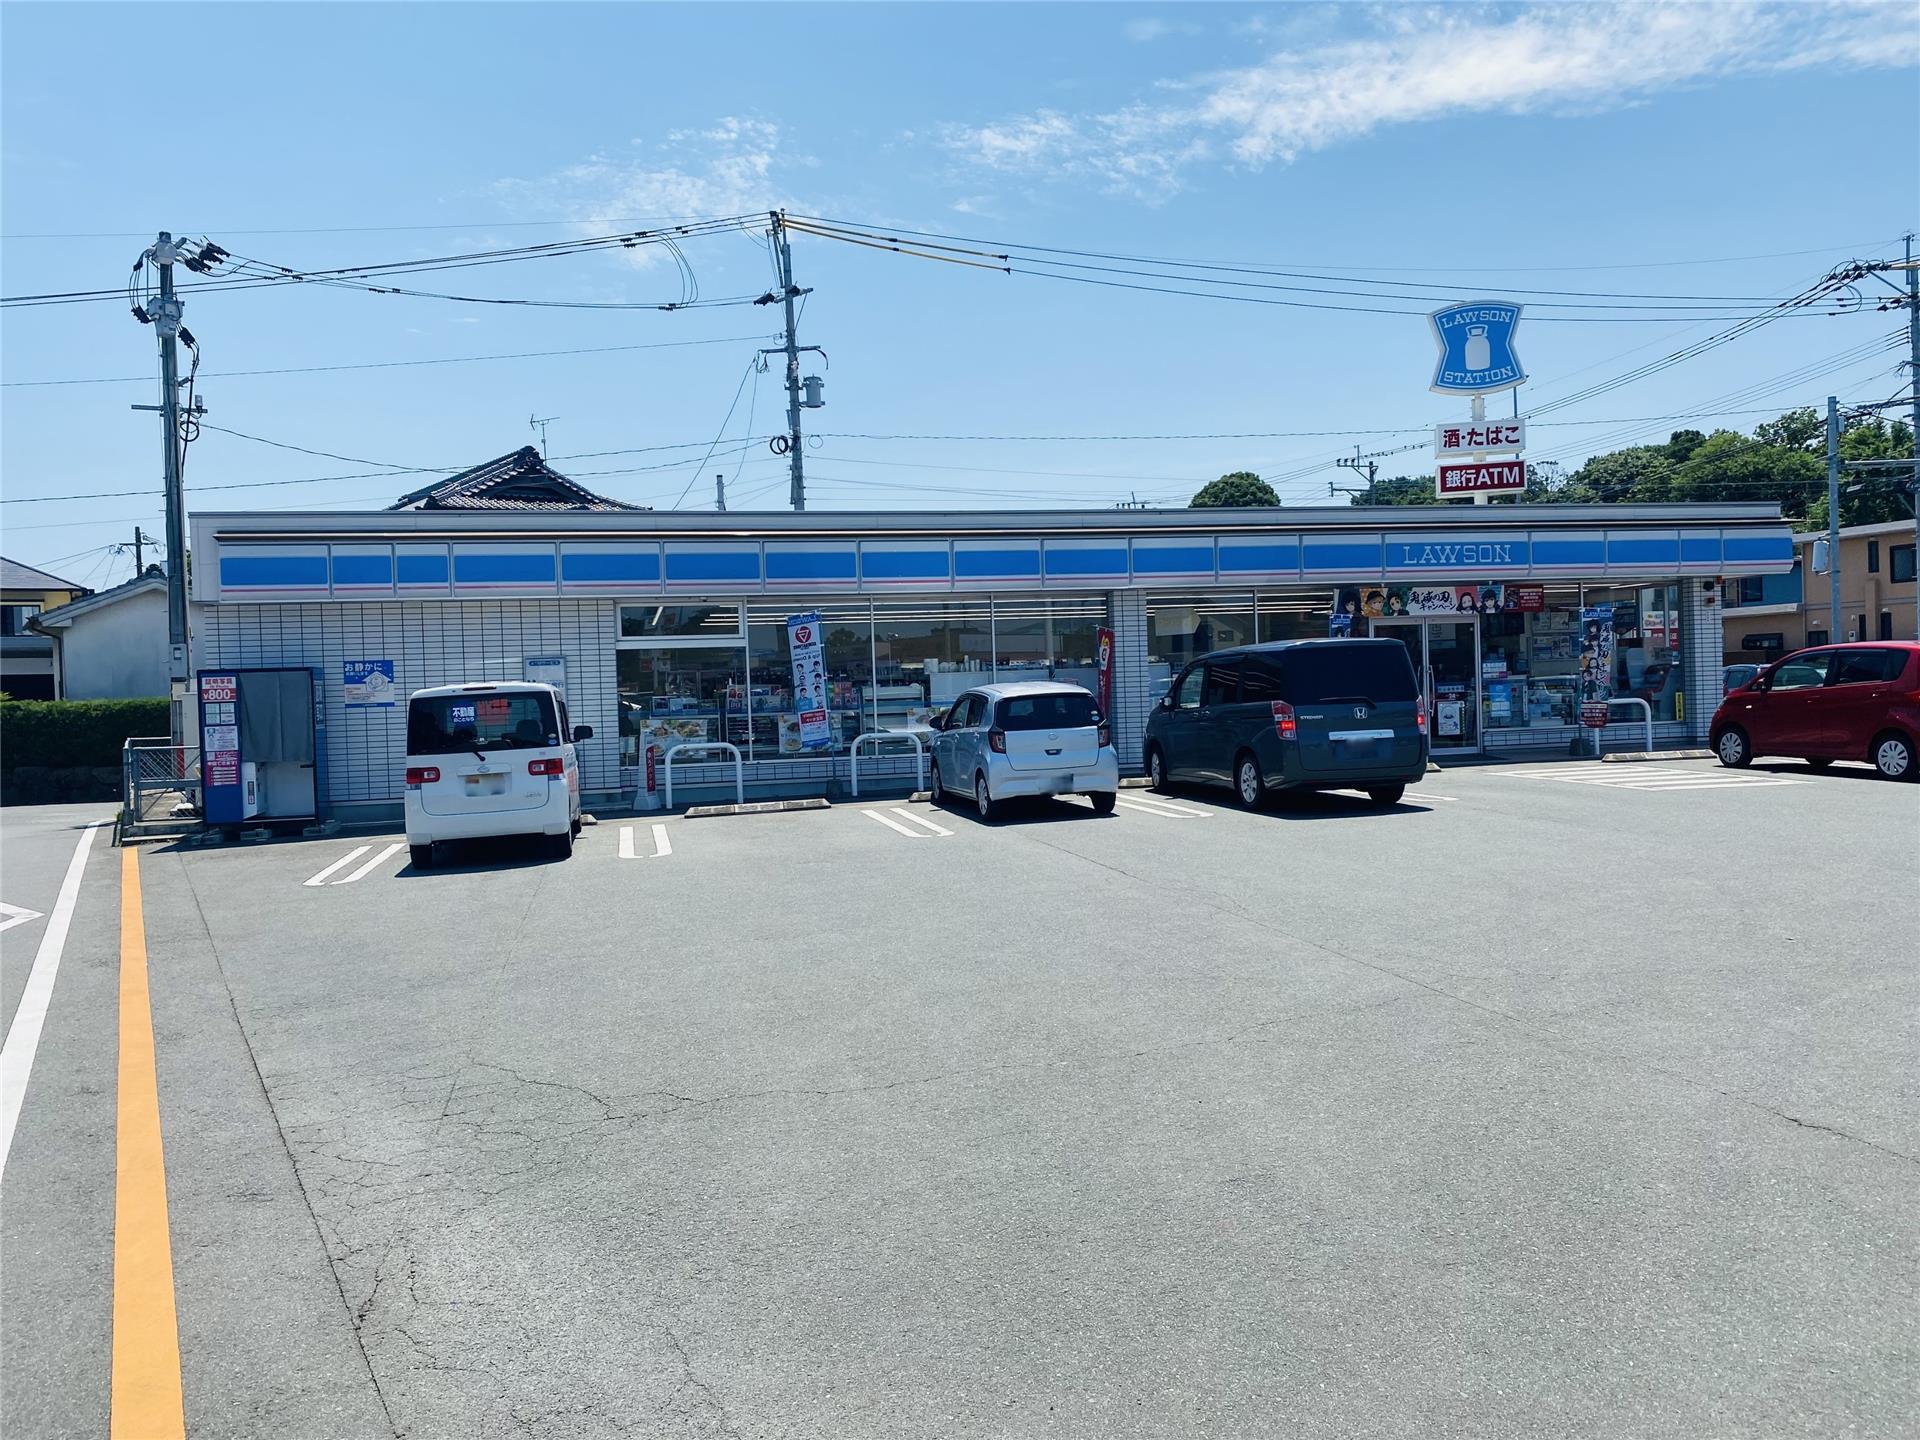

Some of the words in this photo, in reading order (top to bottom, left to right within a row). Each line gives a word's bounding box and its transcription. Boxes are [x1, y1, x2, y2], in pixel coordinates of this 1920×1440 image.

[1441, 310, 1512, 329] LAWSON
[1443, 365, 1514, 385] STATION
[1442, 425, 1521, 449] 酒・たばこ
[1444, 465, 1521, 488] 銀行ATM
[1402, 544, 1512, 564] LAWSON
[1419, 603, 1457, 611] キャンペーン
[452, 706, 475, 717] 不動産
